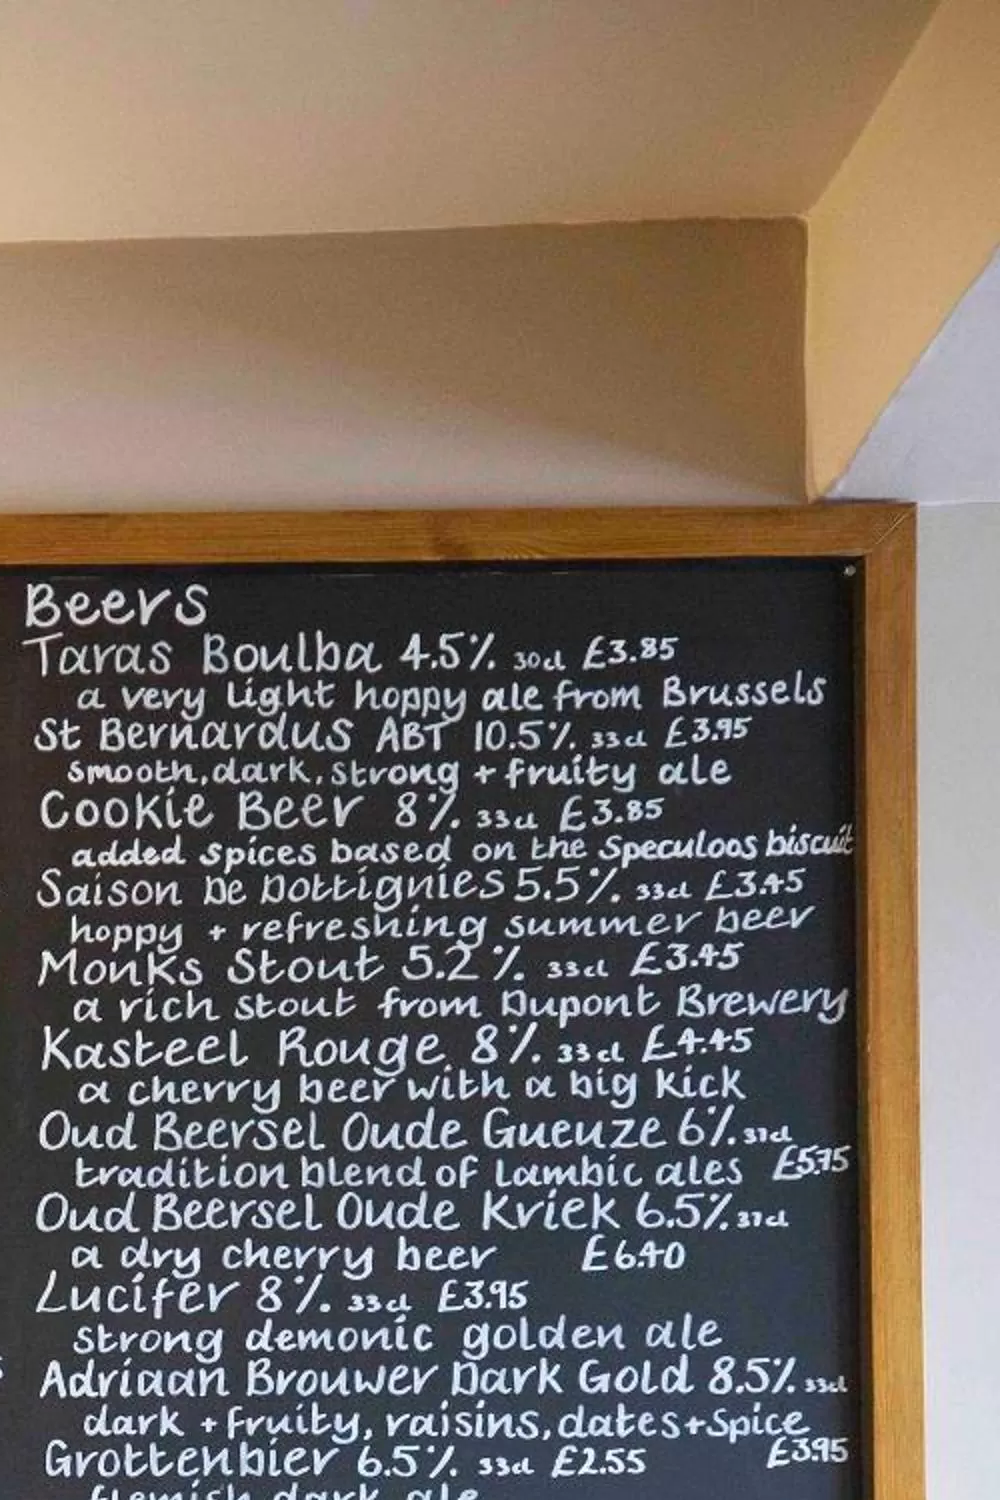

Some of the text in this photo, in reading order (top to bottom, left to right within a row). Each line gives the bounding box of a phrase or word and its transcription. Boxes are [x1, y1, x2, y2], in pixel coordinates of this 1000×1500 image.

[26, 584, 208, 628] Beers
[22, 632, 172, 677] Taras
[203, 630, 382, 675] Boulba
[399, 632, 495, 671] 4.5%
[582, 635, 679, 670] £3.85
[122, 687, 205, 722] very
[355, 679, 466, 722] hoppy
[663, 670, 826, 708] Brussels
[34, 712, 752, 753] St Bernardus ABT 10.5% £3.95
[505, 754, 636, 793] fruity
[40, 786, 664, 832] Cookie Beer 8% £3.85
[72, 834, 186, 868] added
[36, 868, 182, 908] Saison
[705, 868, 806, 901] £3.45
[242, 904, 702, 947] refreshing summer
[227, 945, 384, 984] Stout
[402, 945, 524, 981] 5.2%
[120, 983, 847, 1033] rich Dupont Brewery
[42, 1025, 446, 1077] Kasteel Rouge
[128, 1068, 637, 1114] cherry beer big
[39, 1110, 137, 1151] Oud
[154, 1111, 325, 1152] Beersel
[483, 1107, 667, 1149] Gueuze
[678, 1104, 736, 1147] 6%
[76, 1154, 289, 1189] tradition
[482, 1188, 733, 1231] Kriek 6.5%
[121, 1234, 686, 1284] dry cherry £6.40
[36, 1270, 529, 1319] Lucifer 8% £3.95
[73, 1314, 625, 1366] strong demonic golden
[39, 1354, 694, 1398] Adriaan Brouwer Gold
[84, 1404, 185, 1436] dark
[46, 1437, 339, 1478] Grottenbier
[766, 1436, 848, 1469] £3.95
